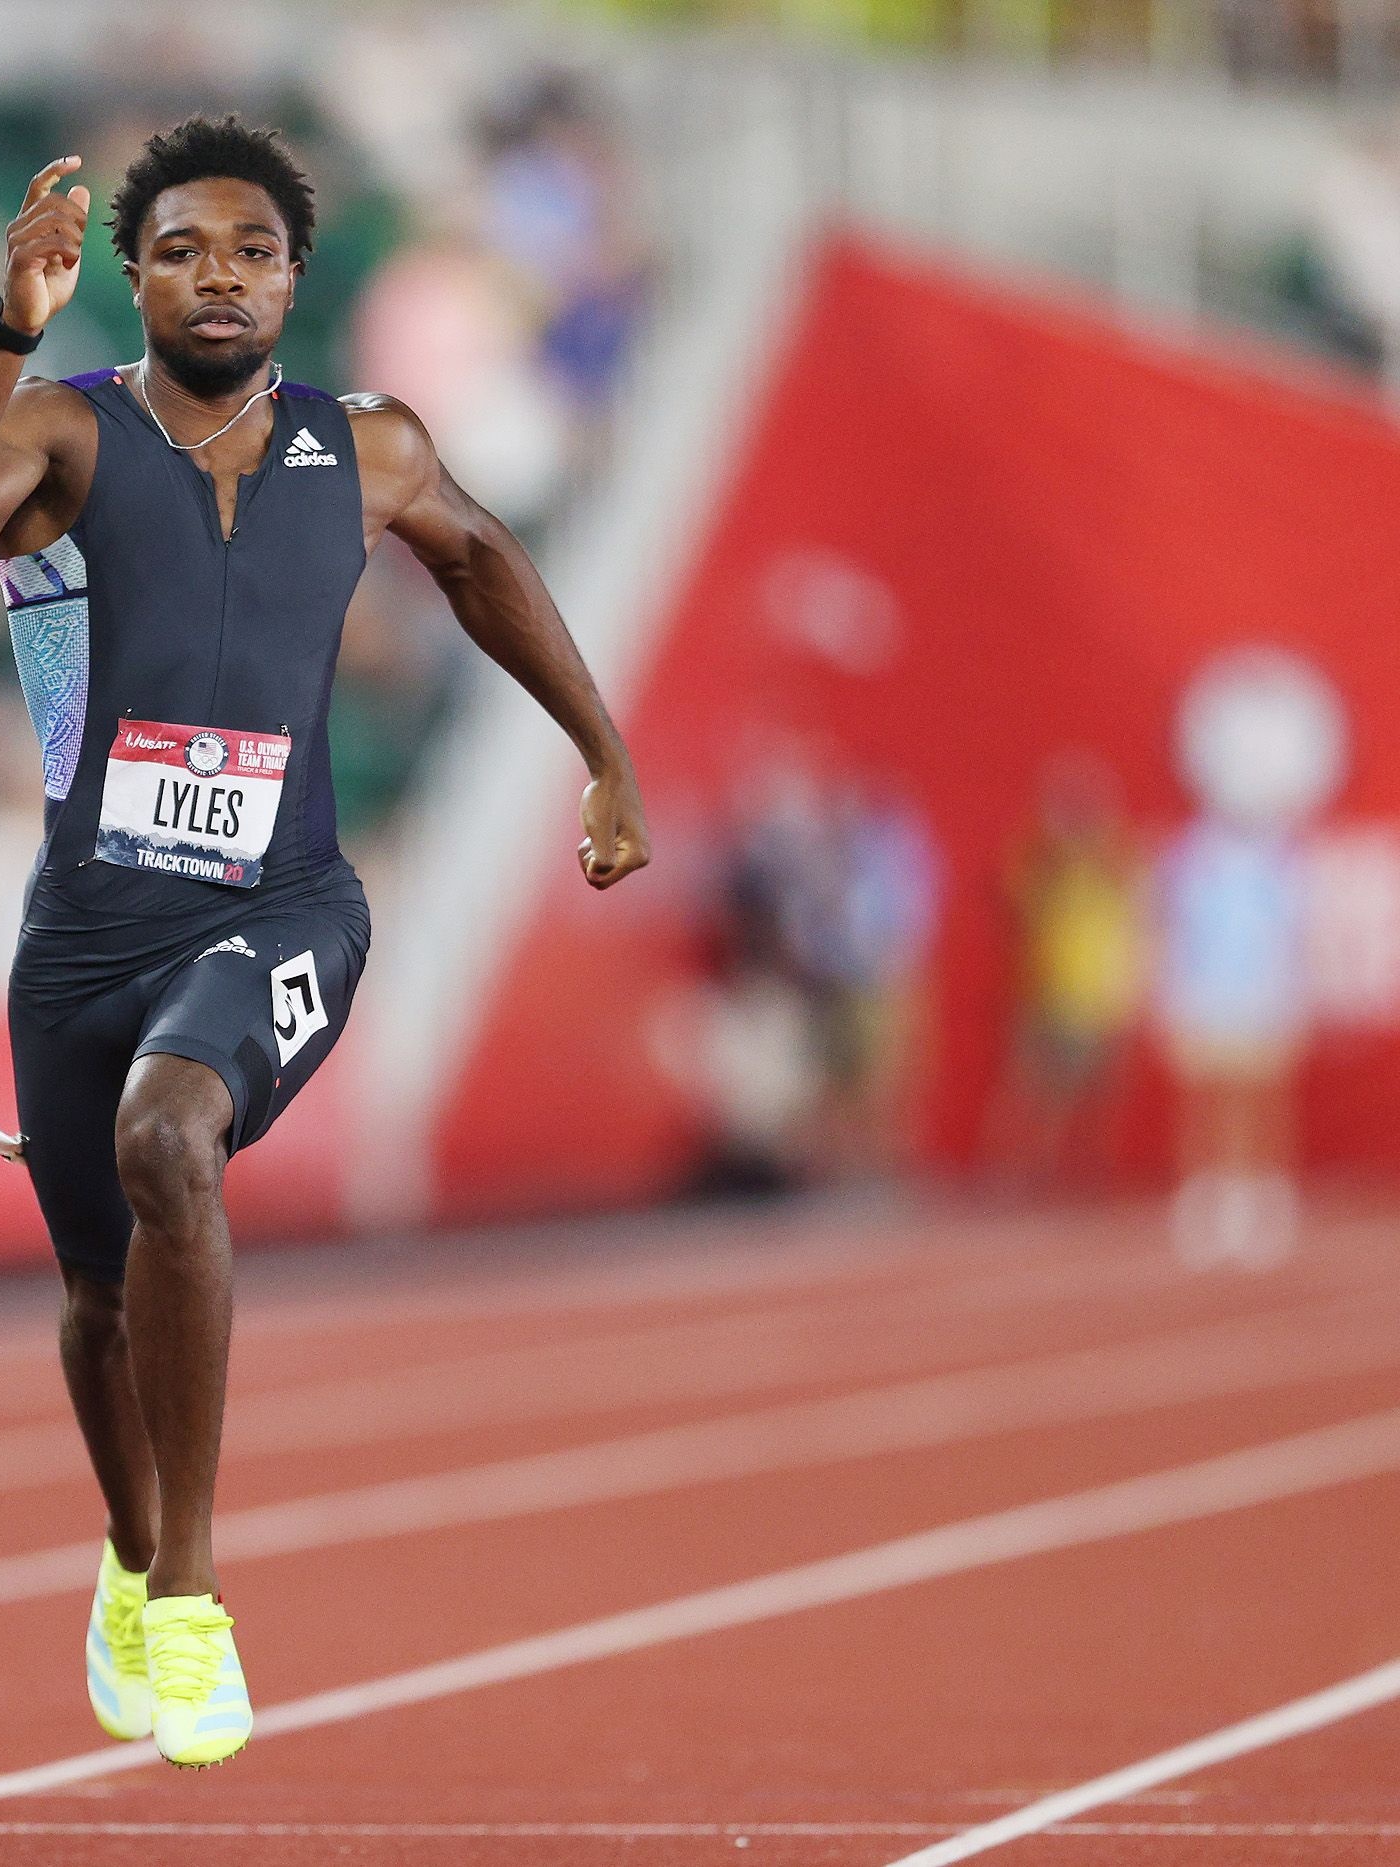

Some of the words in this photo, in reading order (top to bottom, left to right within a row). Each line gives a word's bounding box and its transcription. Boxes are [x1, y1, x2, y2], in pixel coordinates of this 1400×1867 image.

[283, 451, 338, 468] adidas
[138, 738, 178, 750] USATF
[239, 739, 256, 754] U.S.
[237, 766, 254, 774] TRACK
[238, 753, 262, 768] TEAM
[262, 756, 288, 771] TRIALS
[153, 778, 244, 838] LYLES
[136, 848, 244, 882] TRACKTOWN20
[274, 972, 315, 1041] 5
